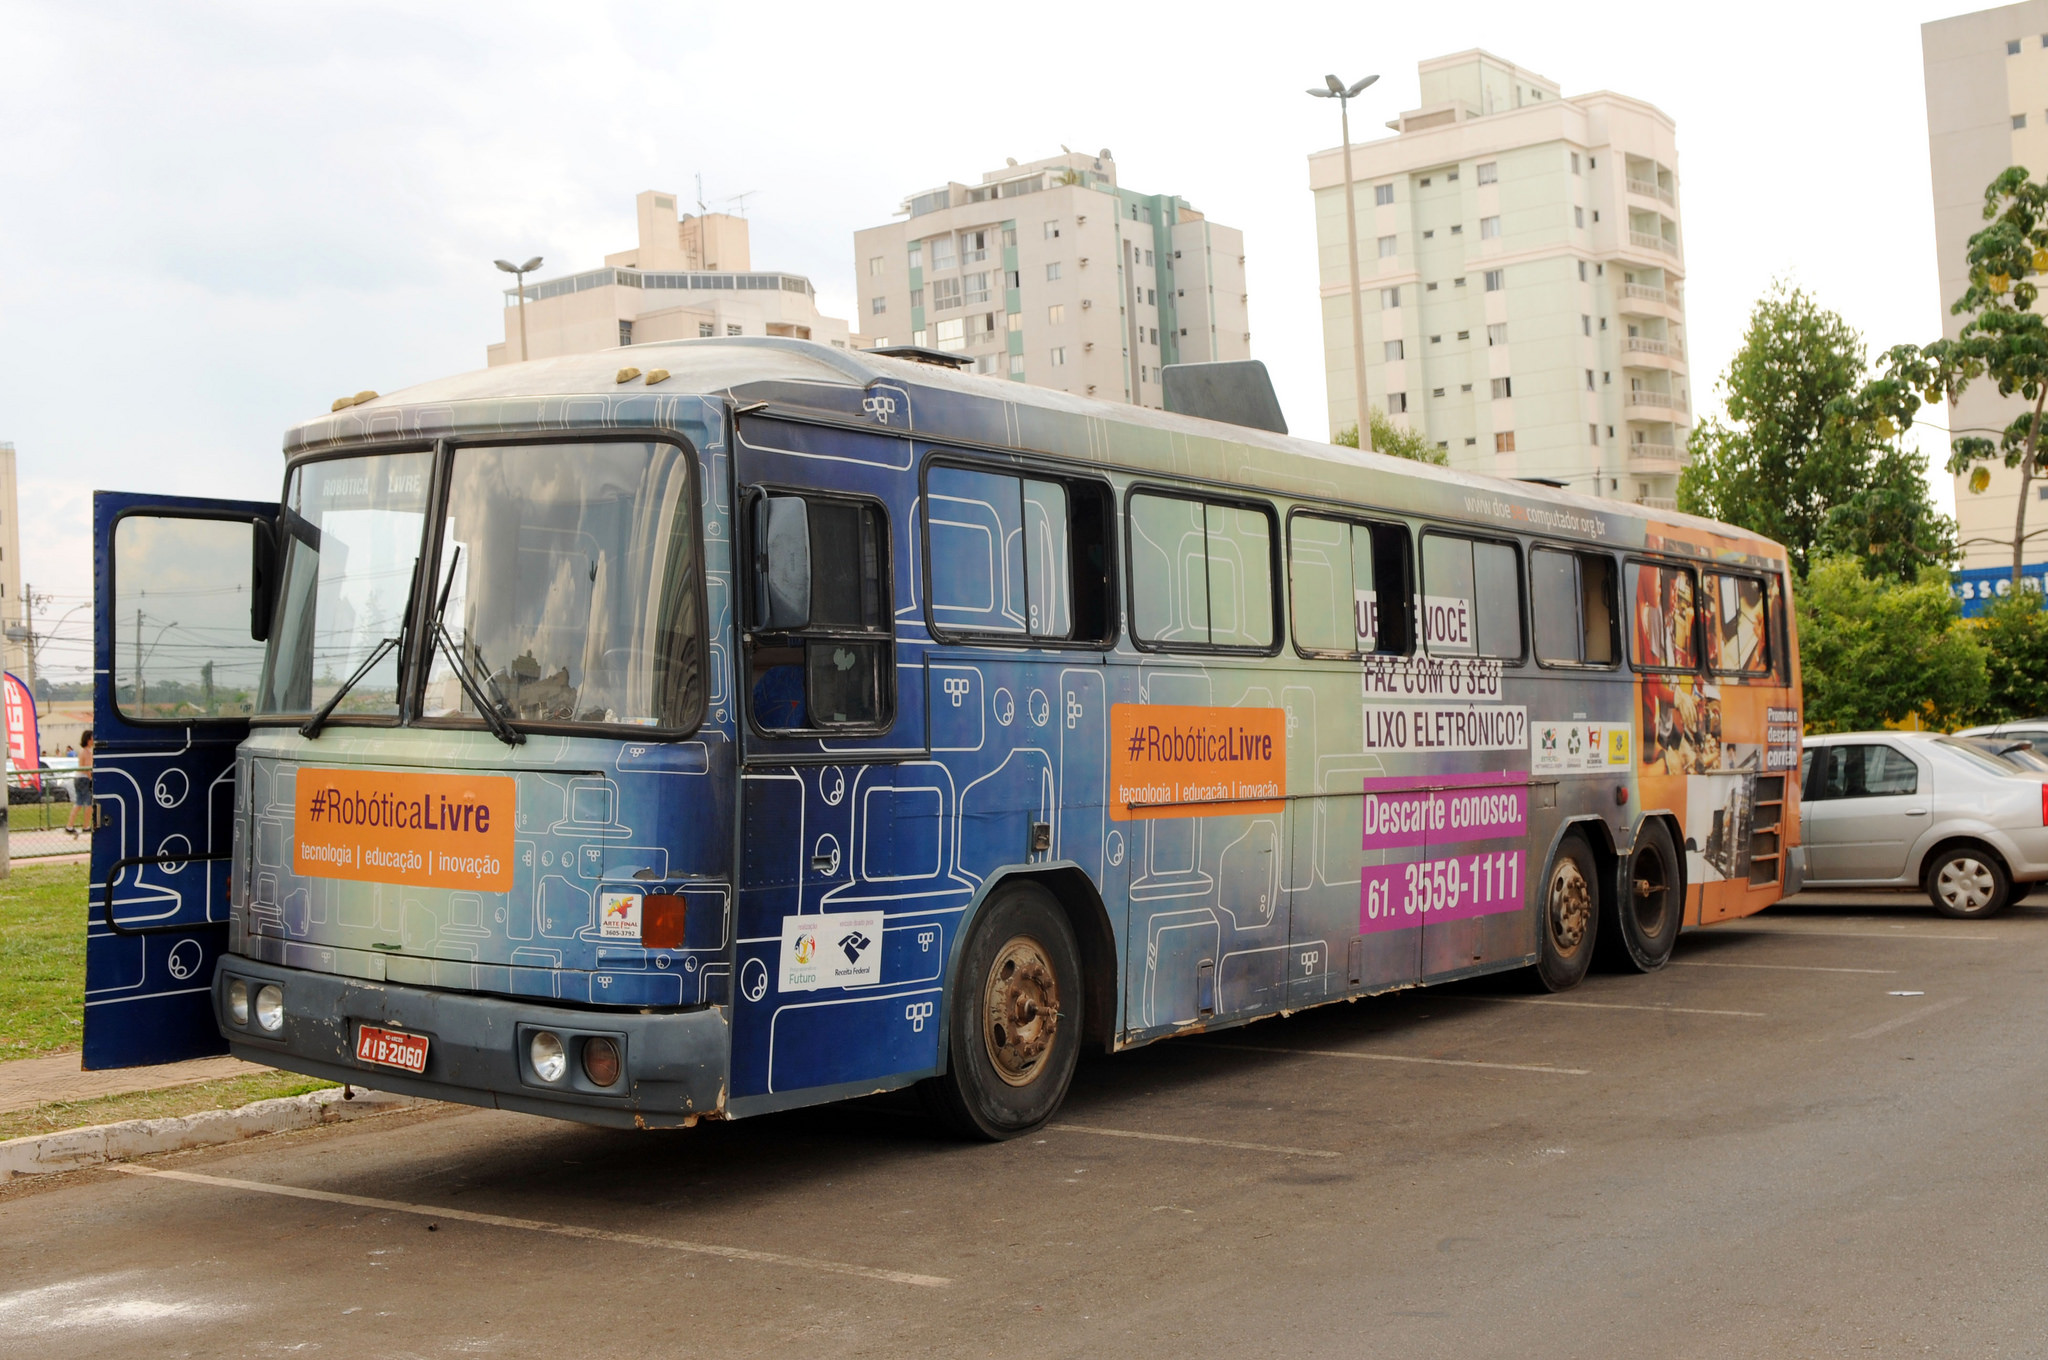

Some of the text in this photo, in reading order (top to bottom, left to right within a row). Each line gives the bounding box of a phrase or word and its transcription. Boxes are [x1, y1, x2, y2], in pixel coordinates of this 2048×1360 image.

[387, 474, 422, 494] LIVRE
[1425, 600, 1468, 643] VOCÊ
[1365, 657, 1498, 695] FAZ COM O SEU
[1128, 725, 1272, 762] #RobóticaLivre
[1365, 703, 1524, 748] LIXO ELETRÔNICO?
[1768, 726, 1797, 743] descate
[310, 788, 490, 833] #RobóticaLivre
[1119, 783, 1171, 804] tecnologia
[1365, 792, 1522, 835] Descarte conosco.
[301, 841, 500, 879] tecnologia educação inovação
[1368, 851, 1518, 919] 61. 3559-1111
[620, 921, 638, 929] FINAL
[789, 973, 816, 984] Futuro
[835, 966, 871, 976] Receita Federal
